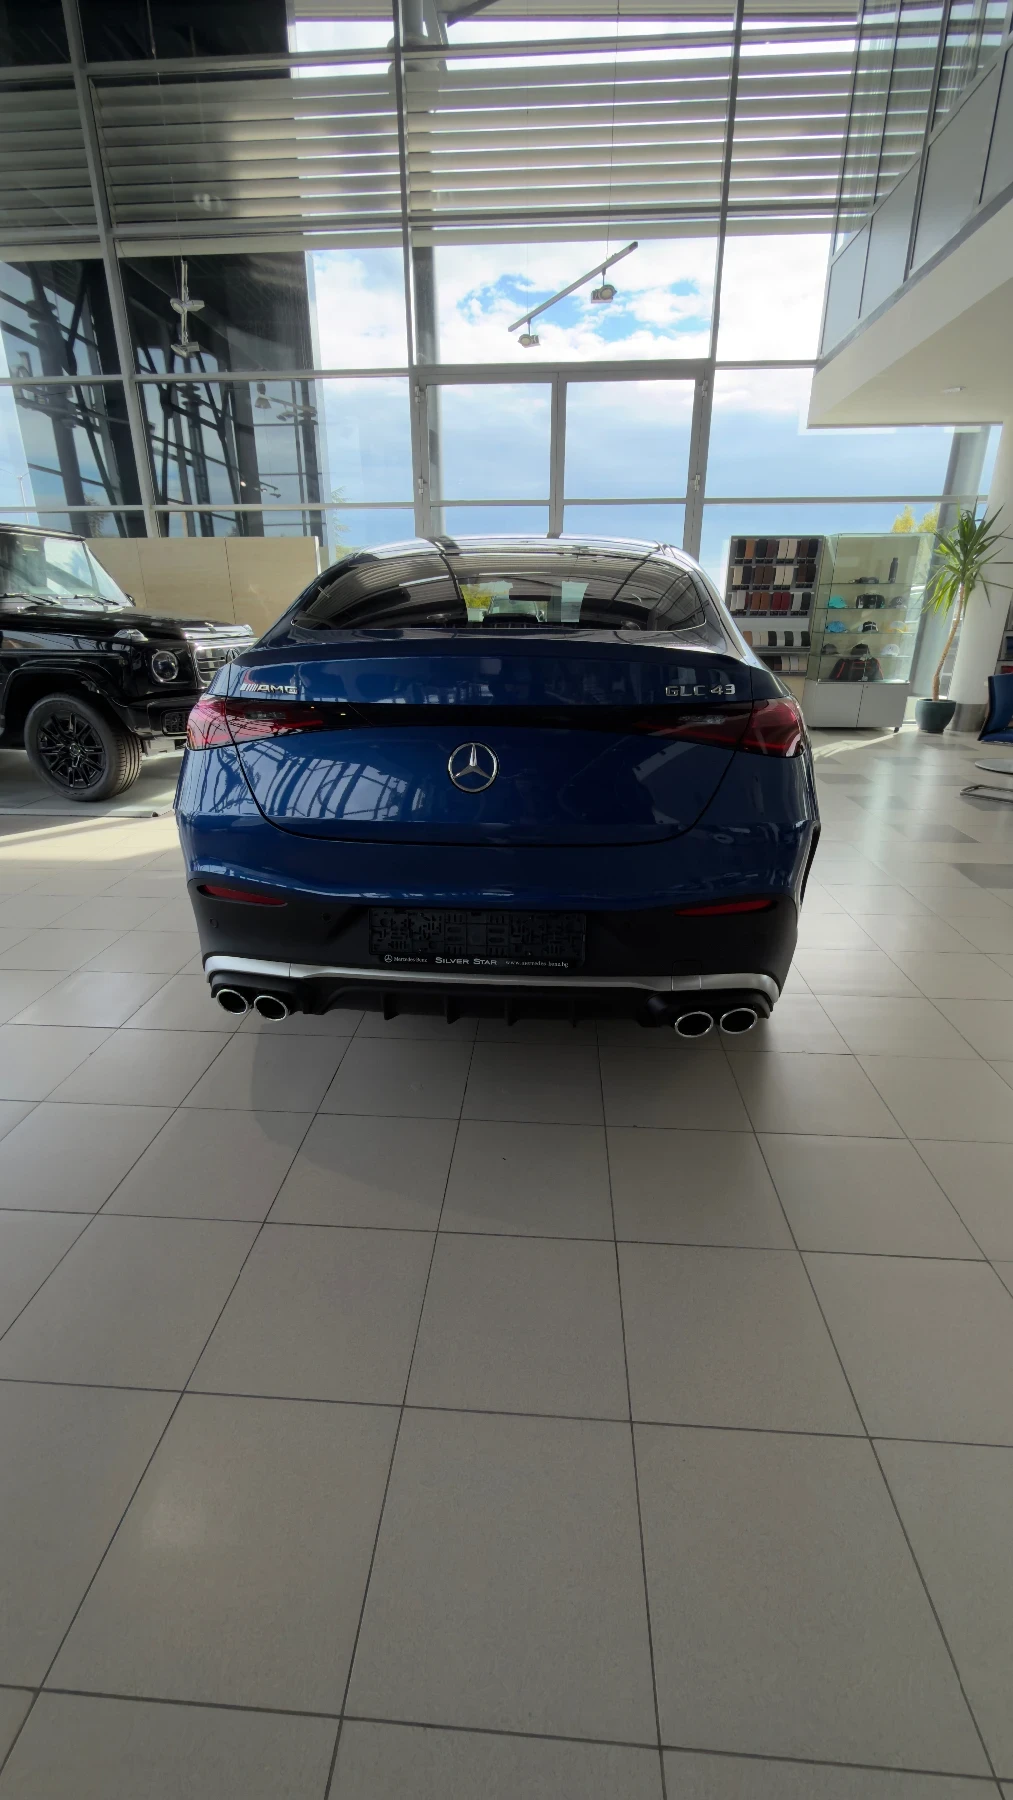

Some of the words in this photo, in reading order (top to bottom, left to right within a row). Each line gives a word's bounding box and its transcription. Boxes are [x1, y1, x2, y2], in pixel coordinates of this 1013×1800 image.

[257, 685, 298, 694] AMG
[665, 685, 706, 696] GLC
[710, 683, 736, 695] 43
